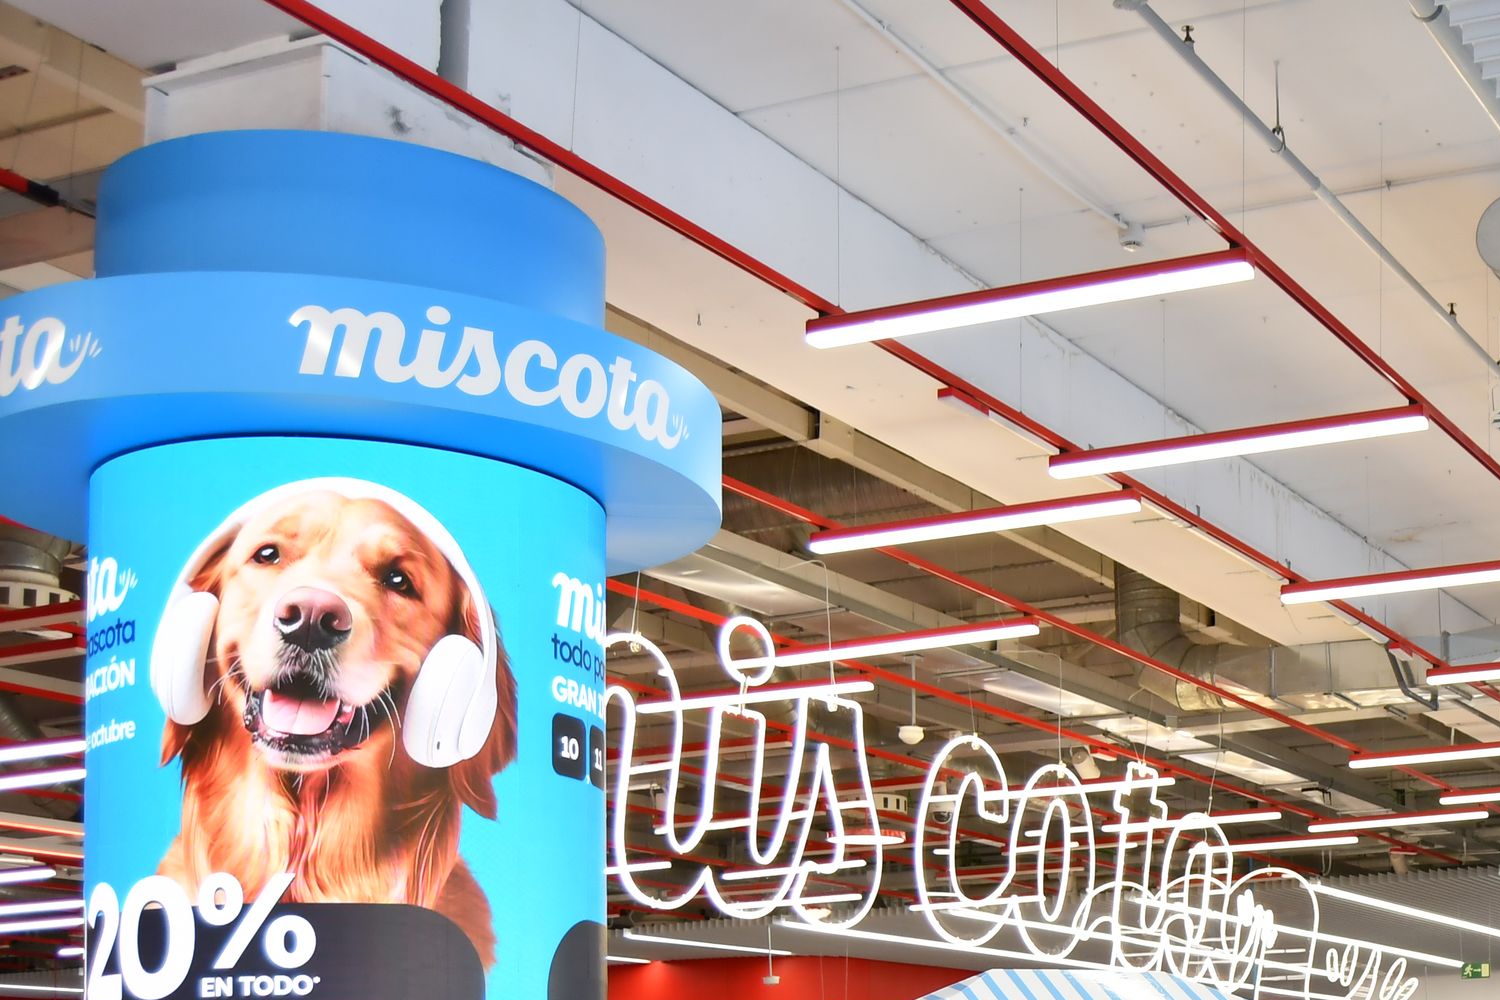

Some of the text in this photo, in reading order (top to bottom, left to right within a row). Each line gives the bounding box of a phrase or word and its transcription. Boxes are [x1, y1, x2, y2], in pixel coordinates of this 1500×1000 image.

[288, 304, 687, 450] miscota
[86, 556, 136, 622] ta
[552, 572, 606, 648] mi
[88, 617, 136, 657] ascota
[551, 633, 592, 670] todo
[551, 675, 596, 712] GRAN
[91, 718, 136, 748] octubre
[560, 736, 580, 761] 10
[594, 747, 603, 771] 11
[201, 976, 233, 998] EN
